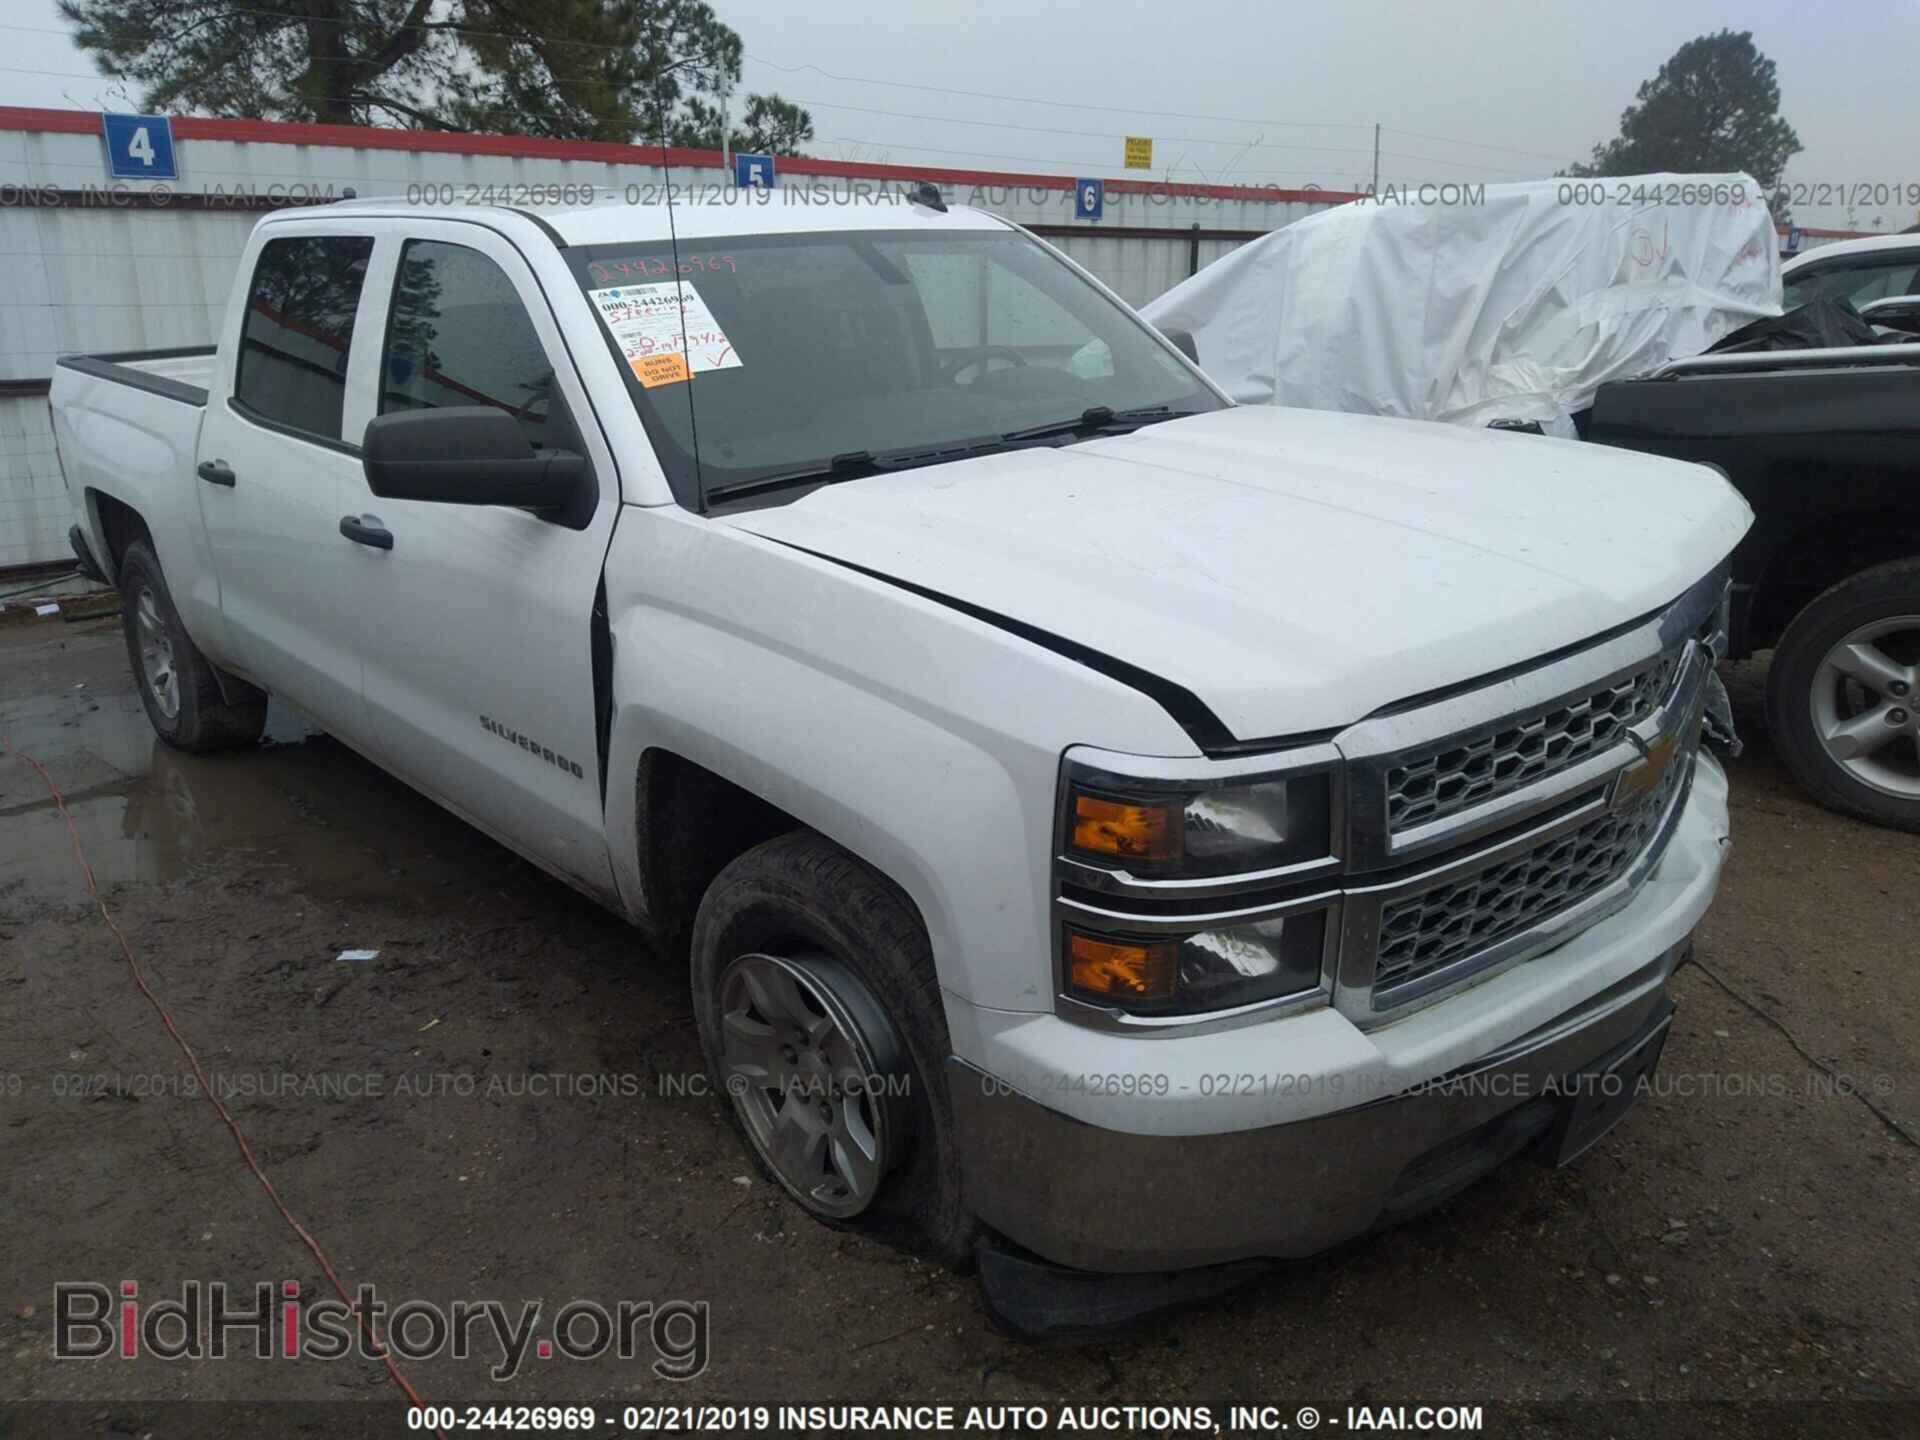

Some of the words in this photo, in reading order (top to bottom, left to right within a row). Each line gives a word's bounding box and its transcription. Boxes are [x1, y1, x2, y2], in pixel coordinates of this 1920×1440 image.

[128, 126, 156, 166] 4
[749, 163, 765, 189] 5
[1084, 185, 1096, 212] 6
[480, 714, 584, 780] SILVERADO
